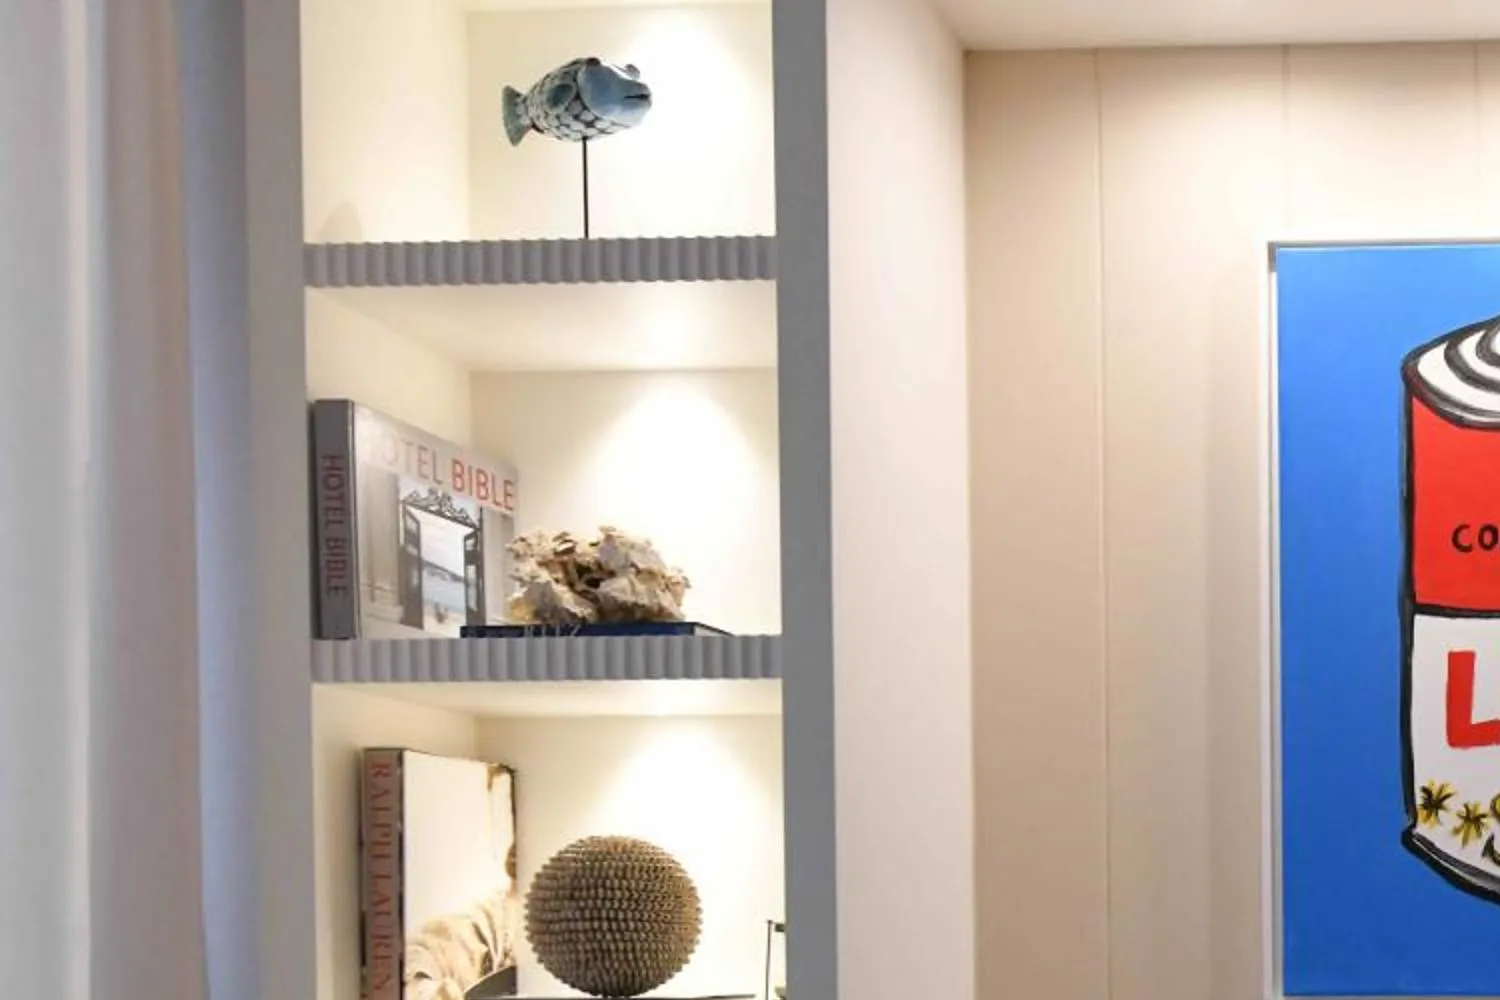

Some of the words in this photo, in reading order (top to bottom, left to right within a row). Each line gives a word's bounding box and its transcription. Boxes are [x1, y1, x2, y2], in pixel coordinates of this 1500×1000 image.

[320, 454, 346, 529] HOTEL
[451, 458, 516, 511] BIBLE
[322, 535, 347, 598] BIBLE
